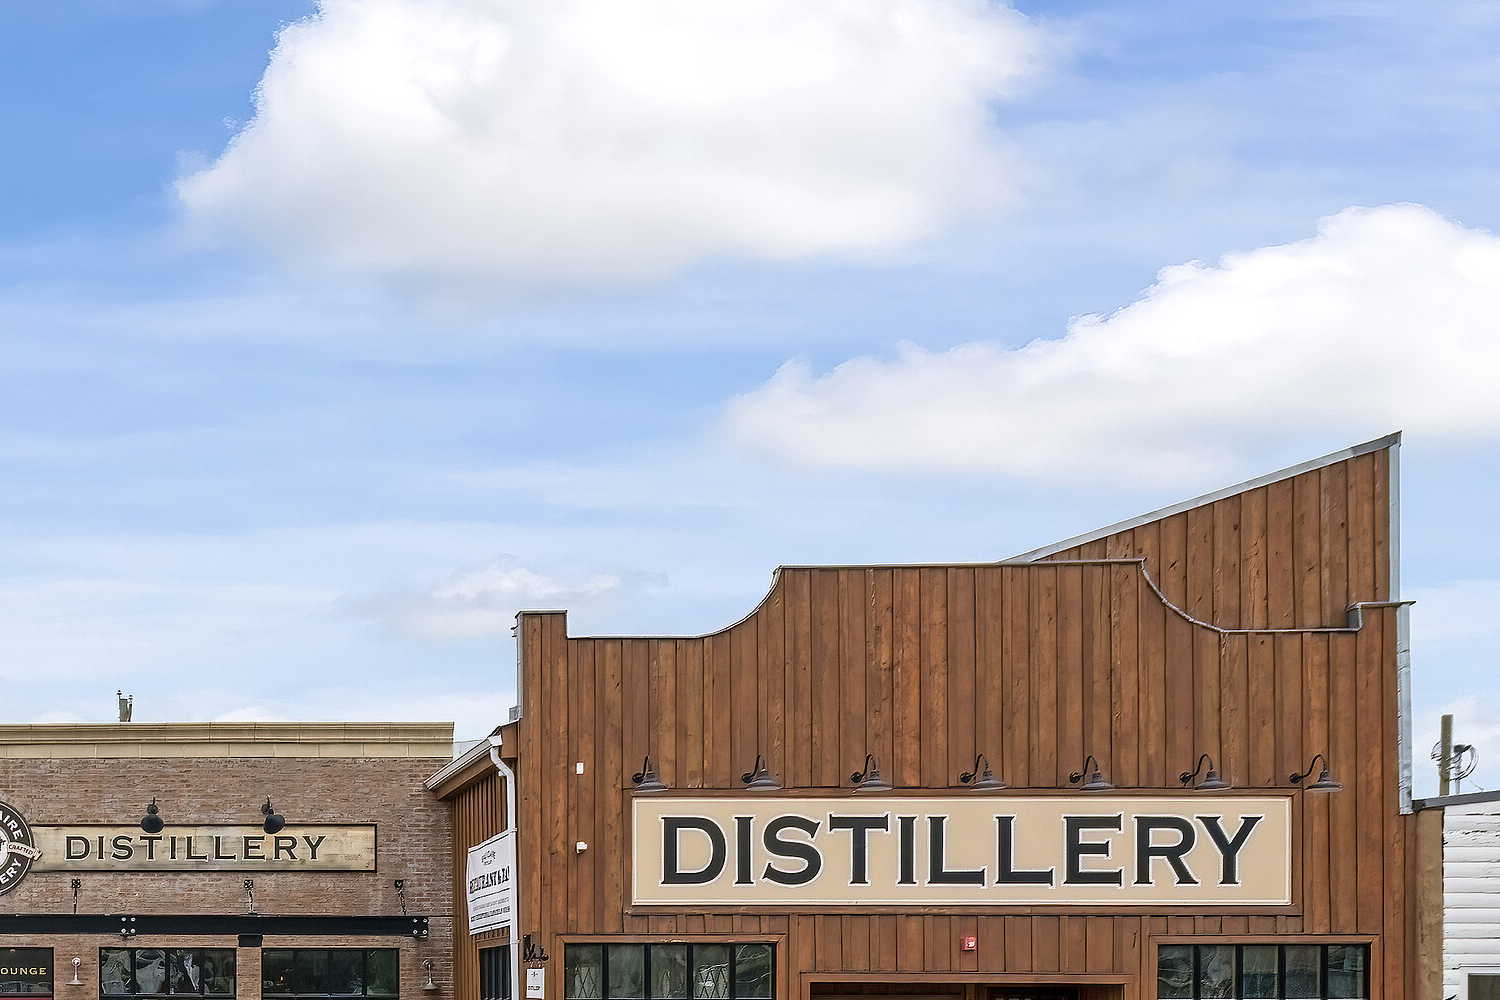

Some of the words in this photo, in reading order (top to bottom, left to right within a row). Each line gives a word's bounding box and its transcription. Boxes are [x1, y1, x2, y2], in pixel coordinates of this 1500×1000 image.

[8, 844, 34, 856] CRAFTED
[65, 834, 327, 861] DISTILLERY
[660, 812, 1264, 888] DISTILLERY
